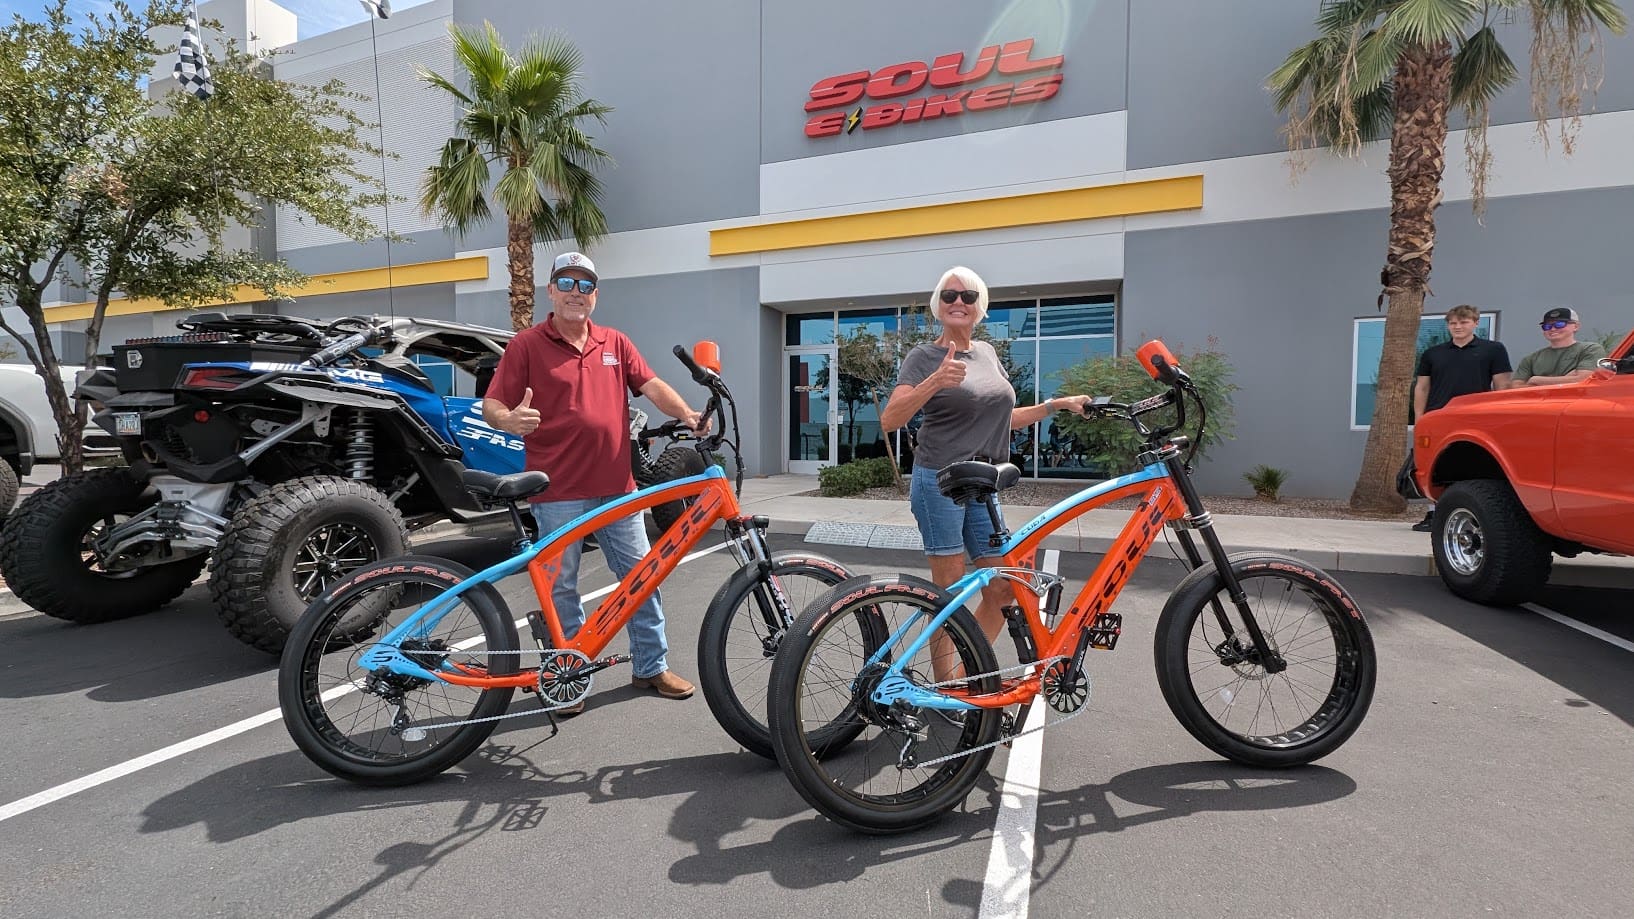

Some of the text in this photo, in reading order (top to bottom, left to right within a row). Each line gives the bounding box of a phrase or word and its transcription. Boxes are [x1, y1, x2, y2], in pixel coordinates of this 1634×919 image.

[804, 38, 1065, 113] SOUL
[862, 73, 1064, 130] BIKES
[596, 496, 721, 636] SOUL
